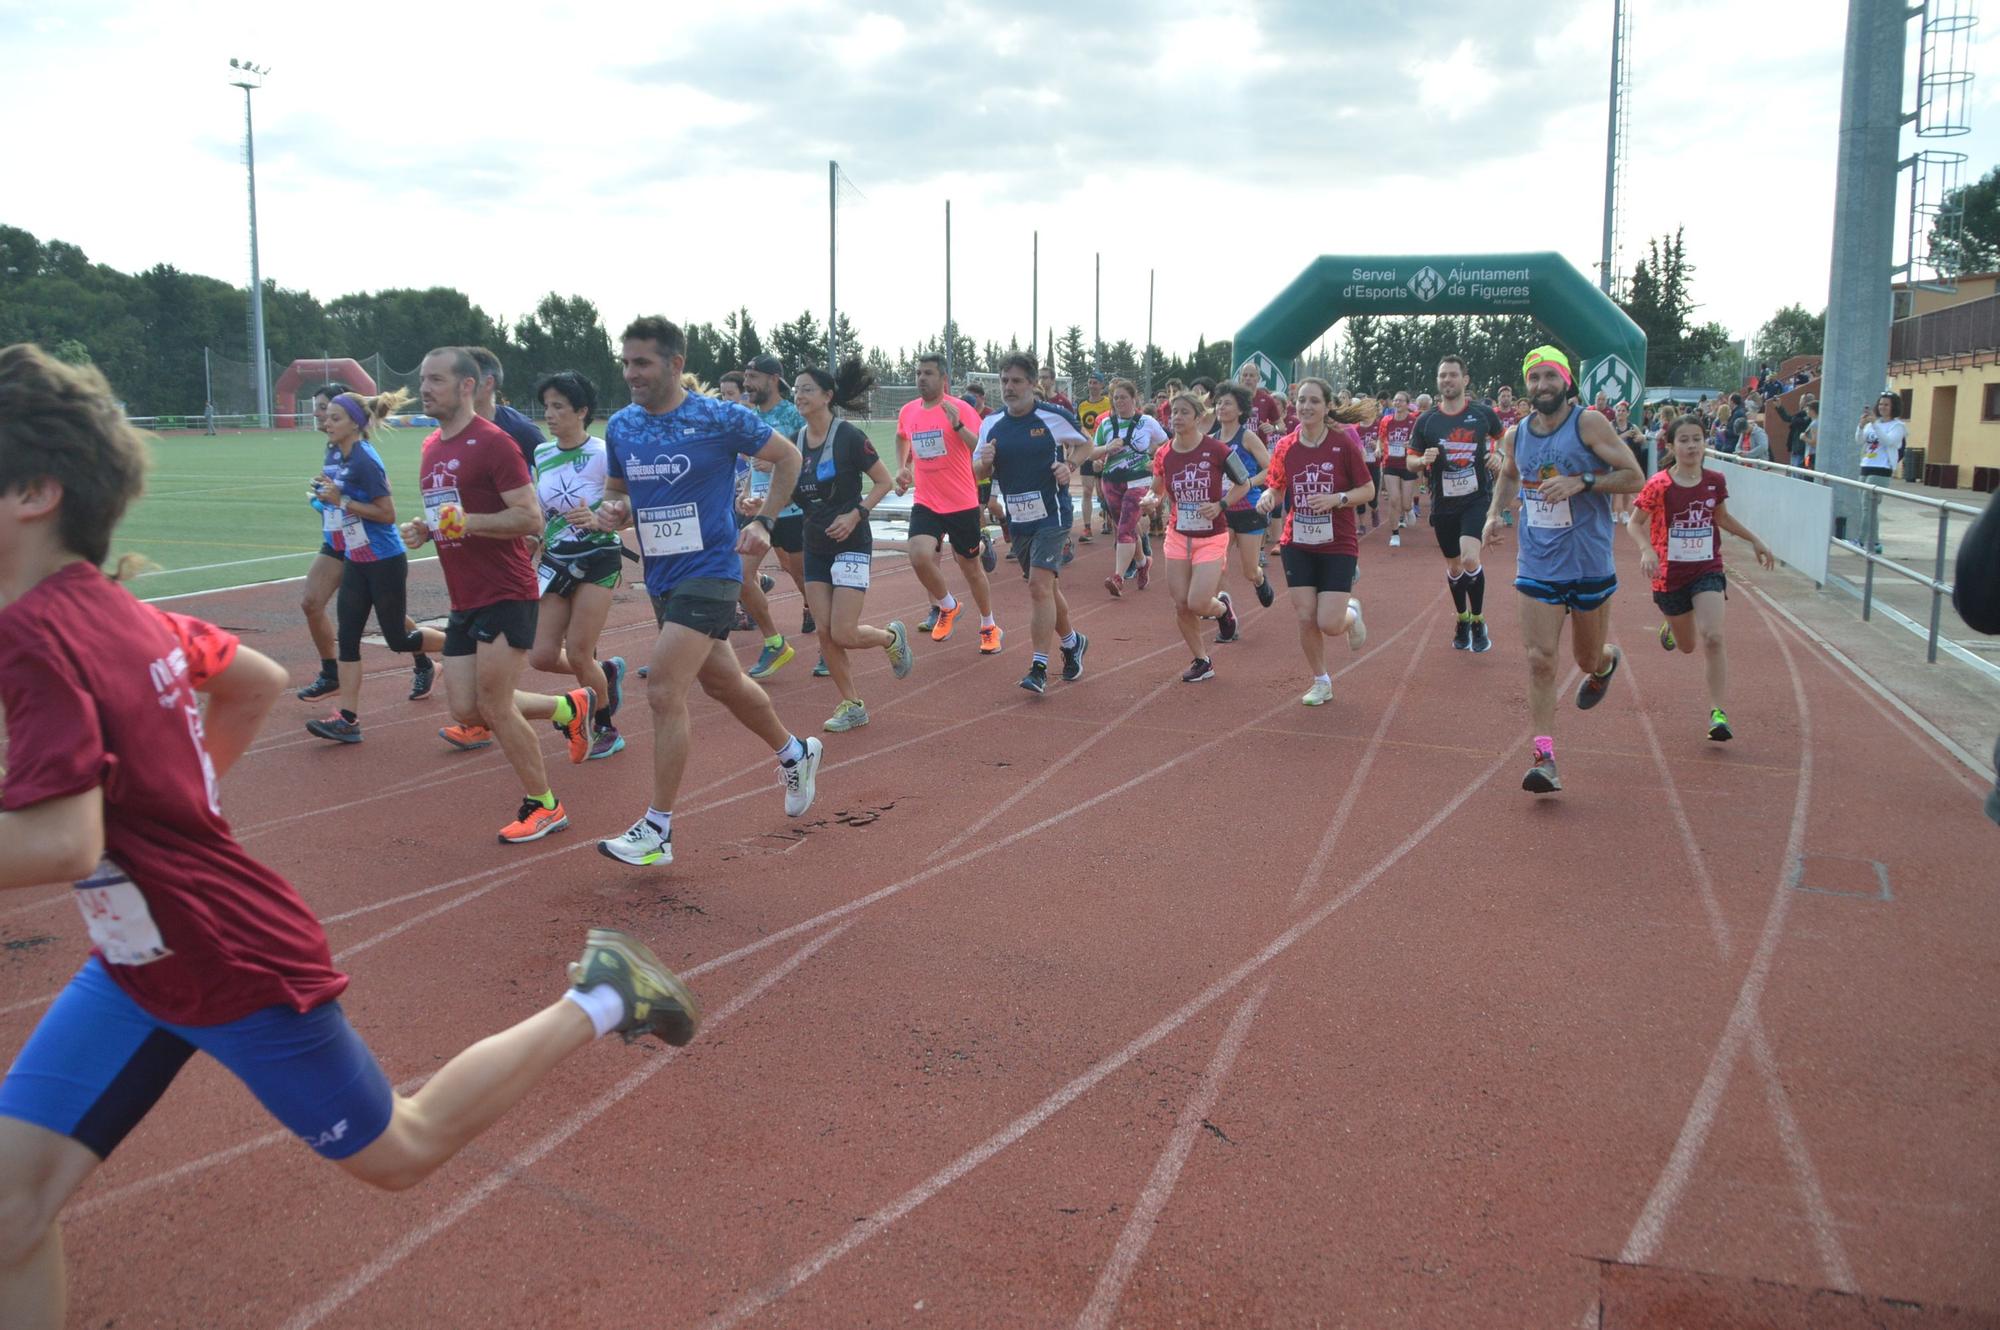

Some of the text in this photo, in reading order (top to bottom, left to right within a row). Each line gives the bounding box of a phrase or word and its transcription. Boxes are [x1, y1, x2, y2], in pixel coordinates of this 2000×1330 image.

[1352, 268, 1396, 281] Servei
[1448, 268, 1530, 284] Ajuntament
[1343, 285, 1407, 300] d'Esports
[1448, 283, 1530, 299] de Figueres
[920, 438, 936, 448] 169
[672, 464, 680, 474] 5K
[1185, 471, 1196, 480] XV
[1306, 473, 1319, 482] XV
[1174, 480, 1208, 490] RUN
[1295, 484, 1331, 494] RUN
[1452, 479, 1468, 488] 146
[1174, 488, 1210, 502] CASTELL
[1016, 500, 1033, 511] 176
[1536, 501, 1555, 512] 147
[655, 510, 667, 520] RUN
[1689, 510, 1703, 522] XV
[653, 522, 682, 538] 202
[1303, 525, 1321, 534] 194
[1681, 538, 1703, 549] 310
[845, 562, 858, 573] 52
